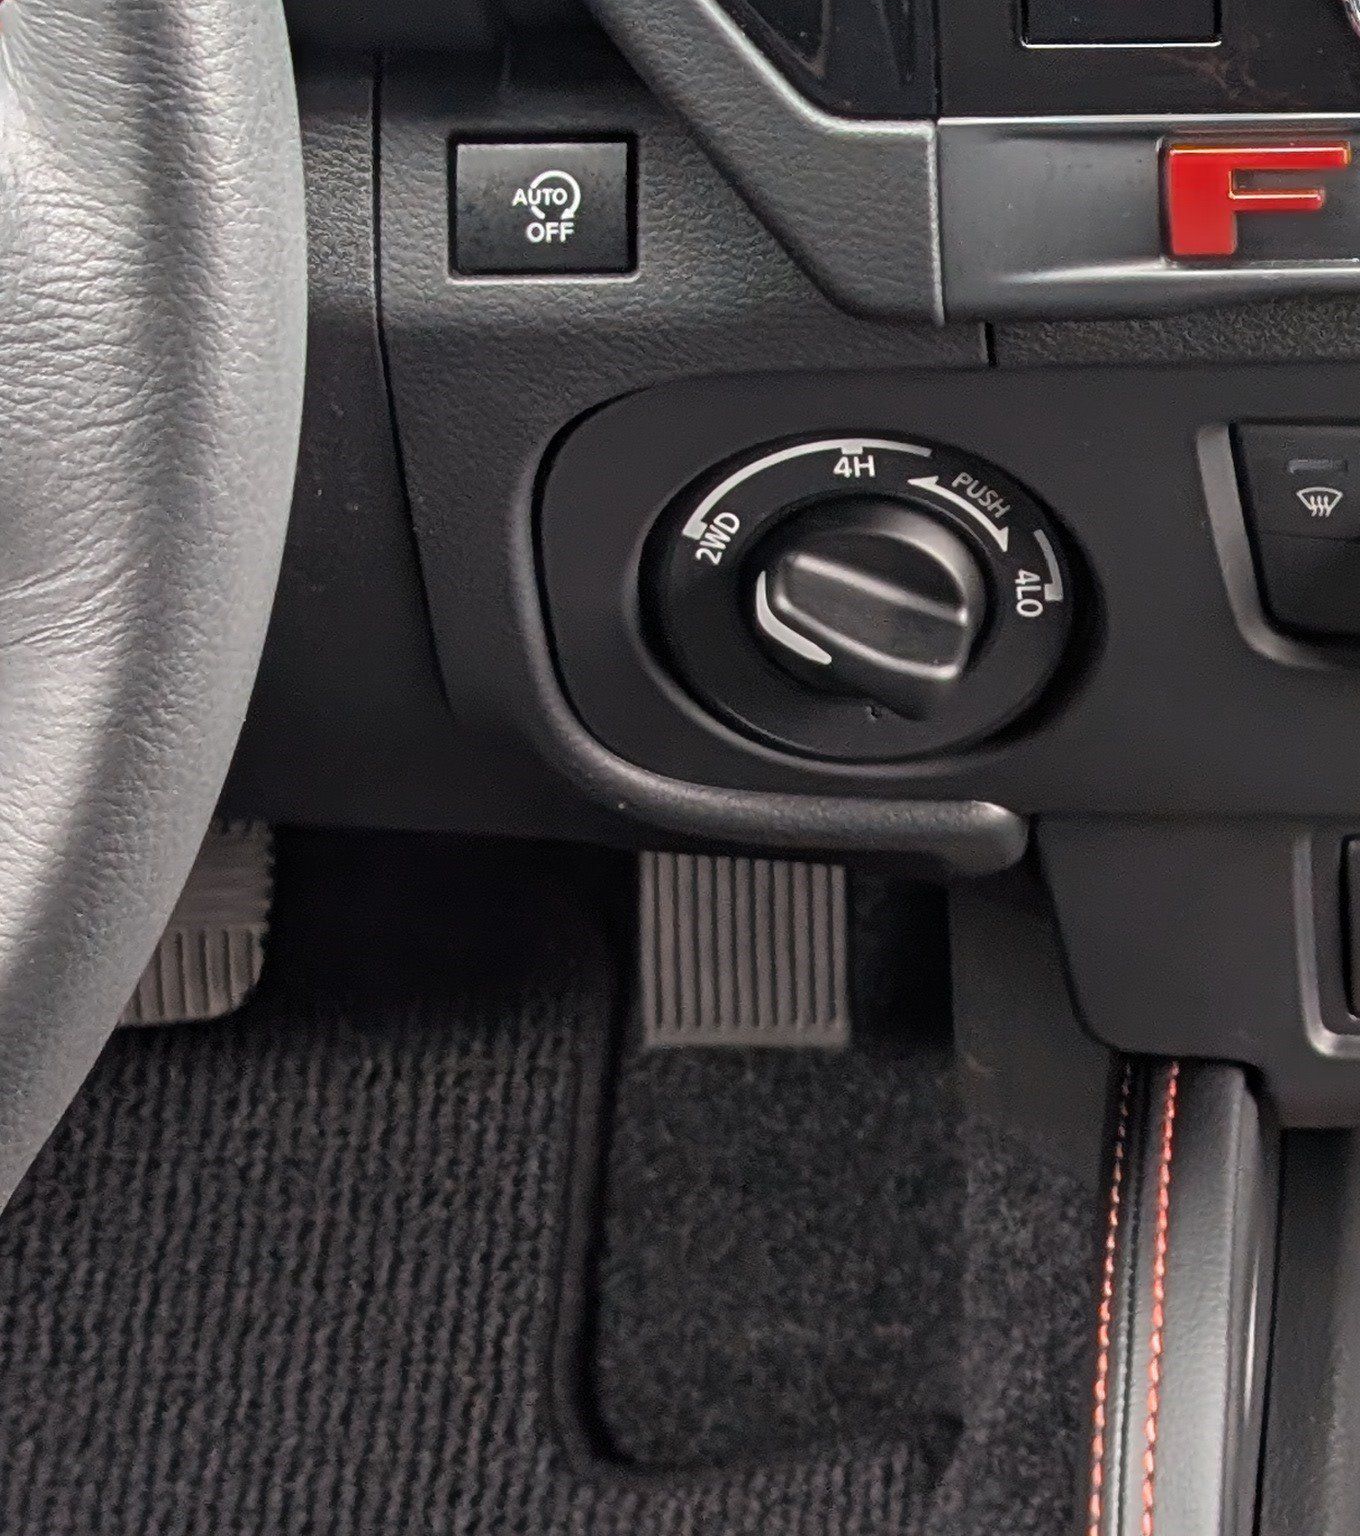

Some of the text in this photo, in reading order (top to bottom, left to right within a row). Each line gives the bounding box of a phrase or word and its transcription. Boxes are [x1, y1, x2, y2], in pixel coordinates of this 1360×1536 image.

[512, 186, 568, 208] AUTO
[526, 221, 573, 243] OFF
[833, 455, 875, 478] 4H
[951, 472, 1010, 518] PUSH
[696, 512, 740, 565] 2WD
[1014, 569, 1044, 618] 4LO
